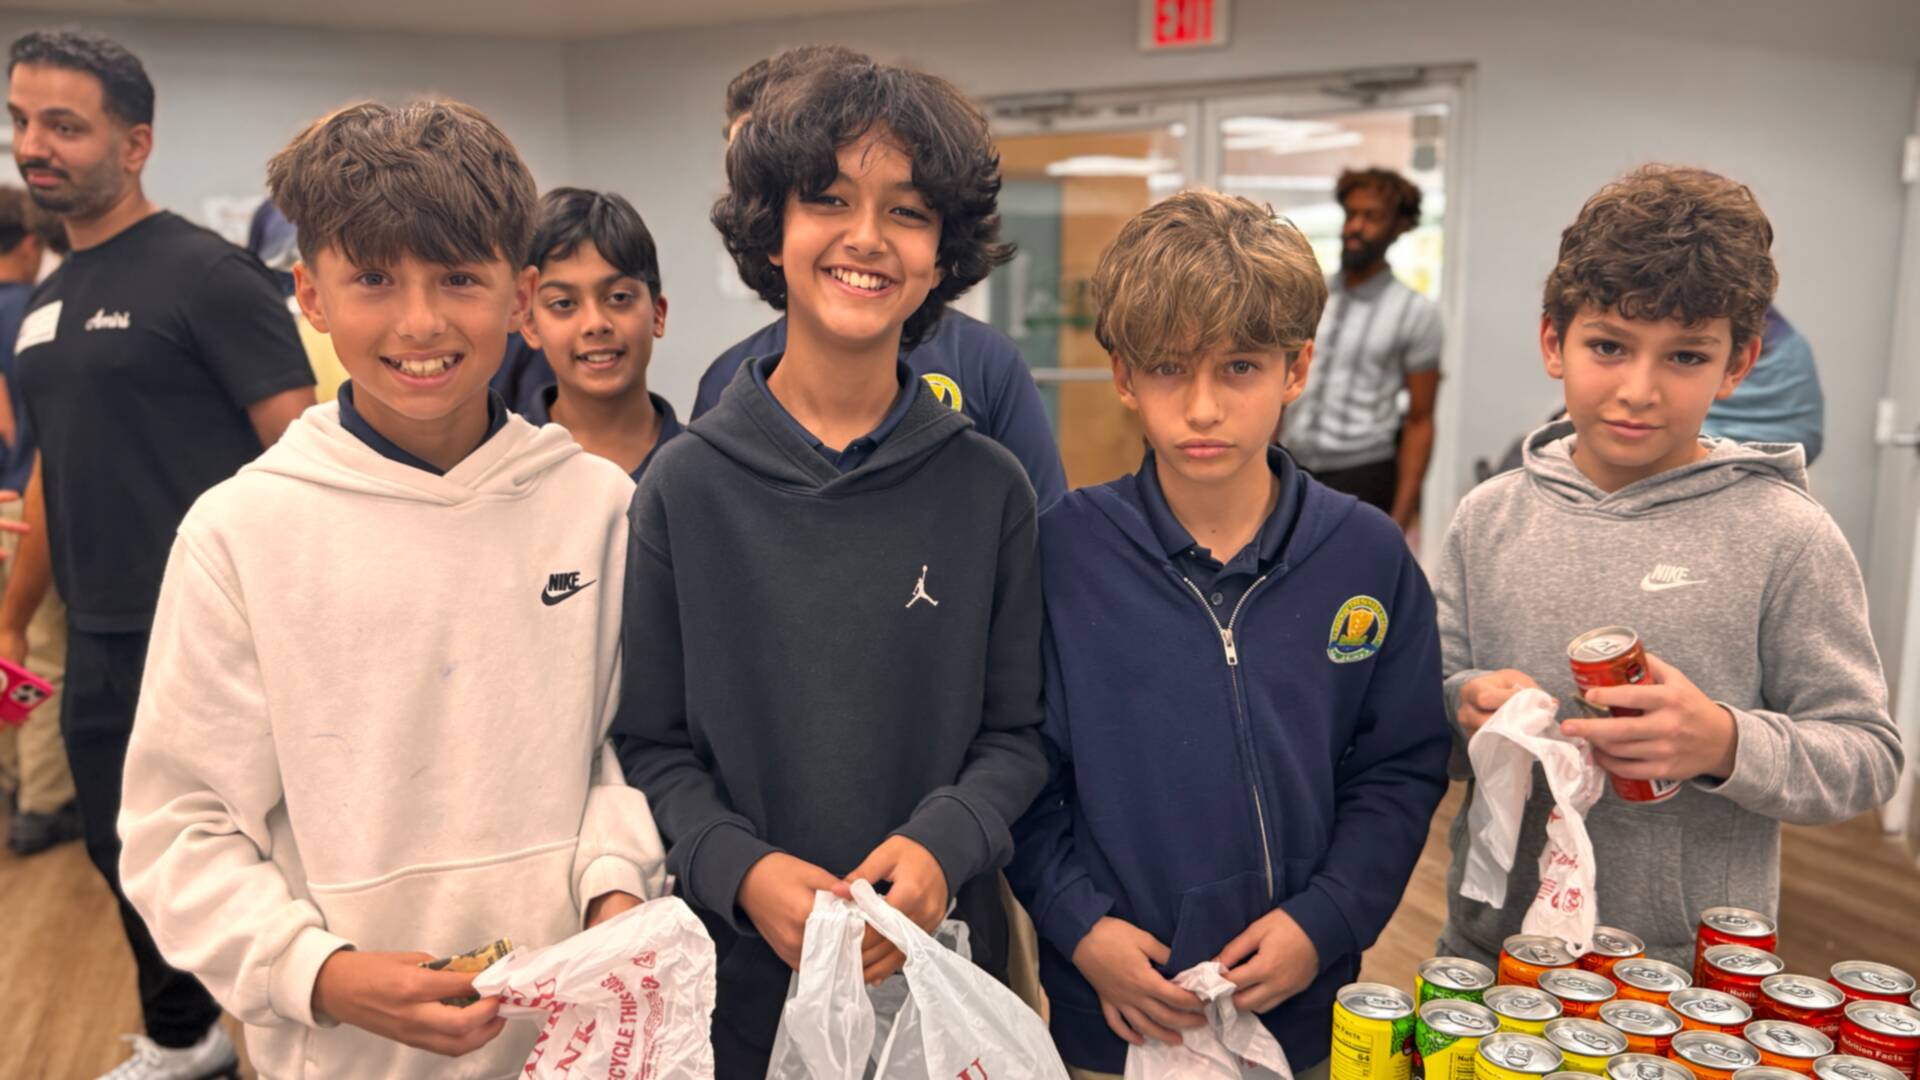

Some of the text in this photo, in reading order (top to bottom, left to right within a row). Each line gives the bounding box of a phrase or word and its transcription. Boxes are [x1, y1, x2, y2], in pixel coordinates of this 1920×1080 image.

[1153, 0, 1214, 45] EXIT
[548, 571, 581, 591] NIKE
[1651, 564, 1690, 582] NIKE
[619, 991, 638, 1024] THIS
